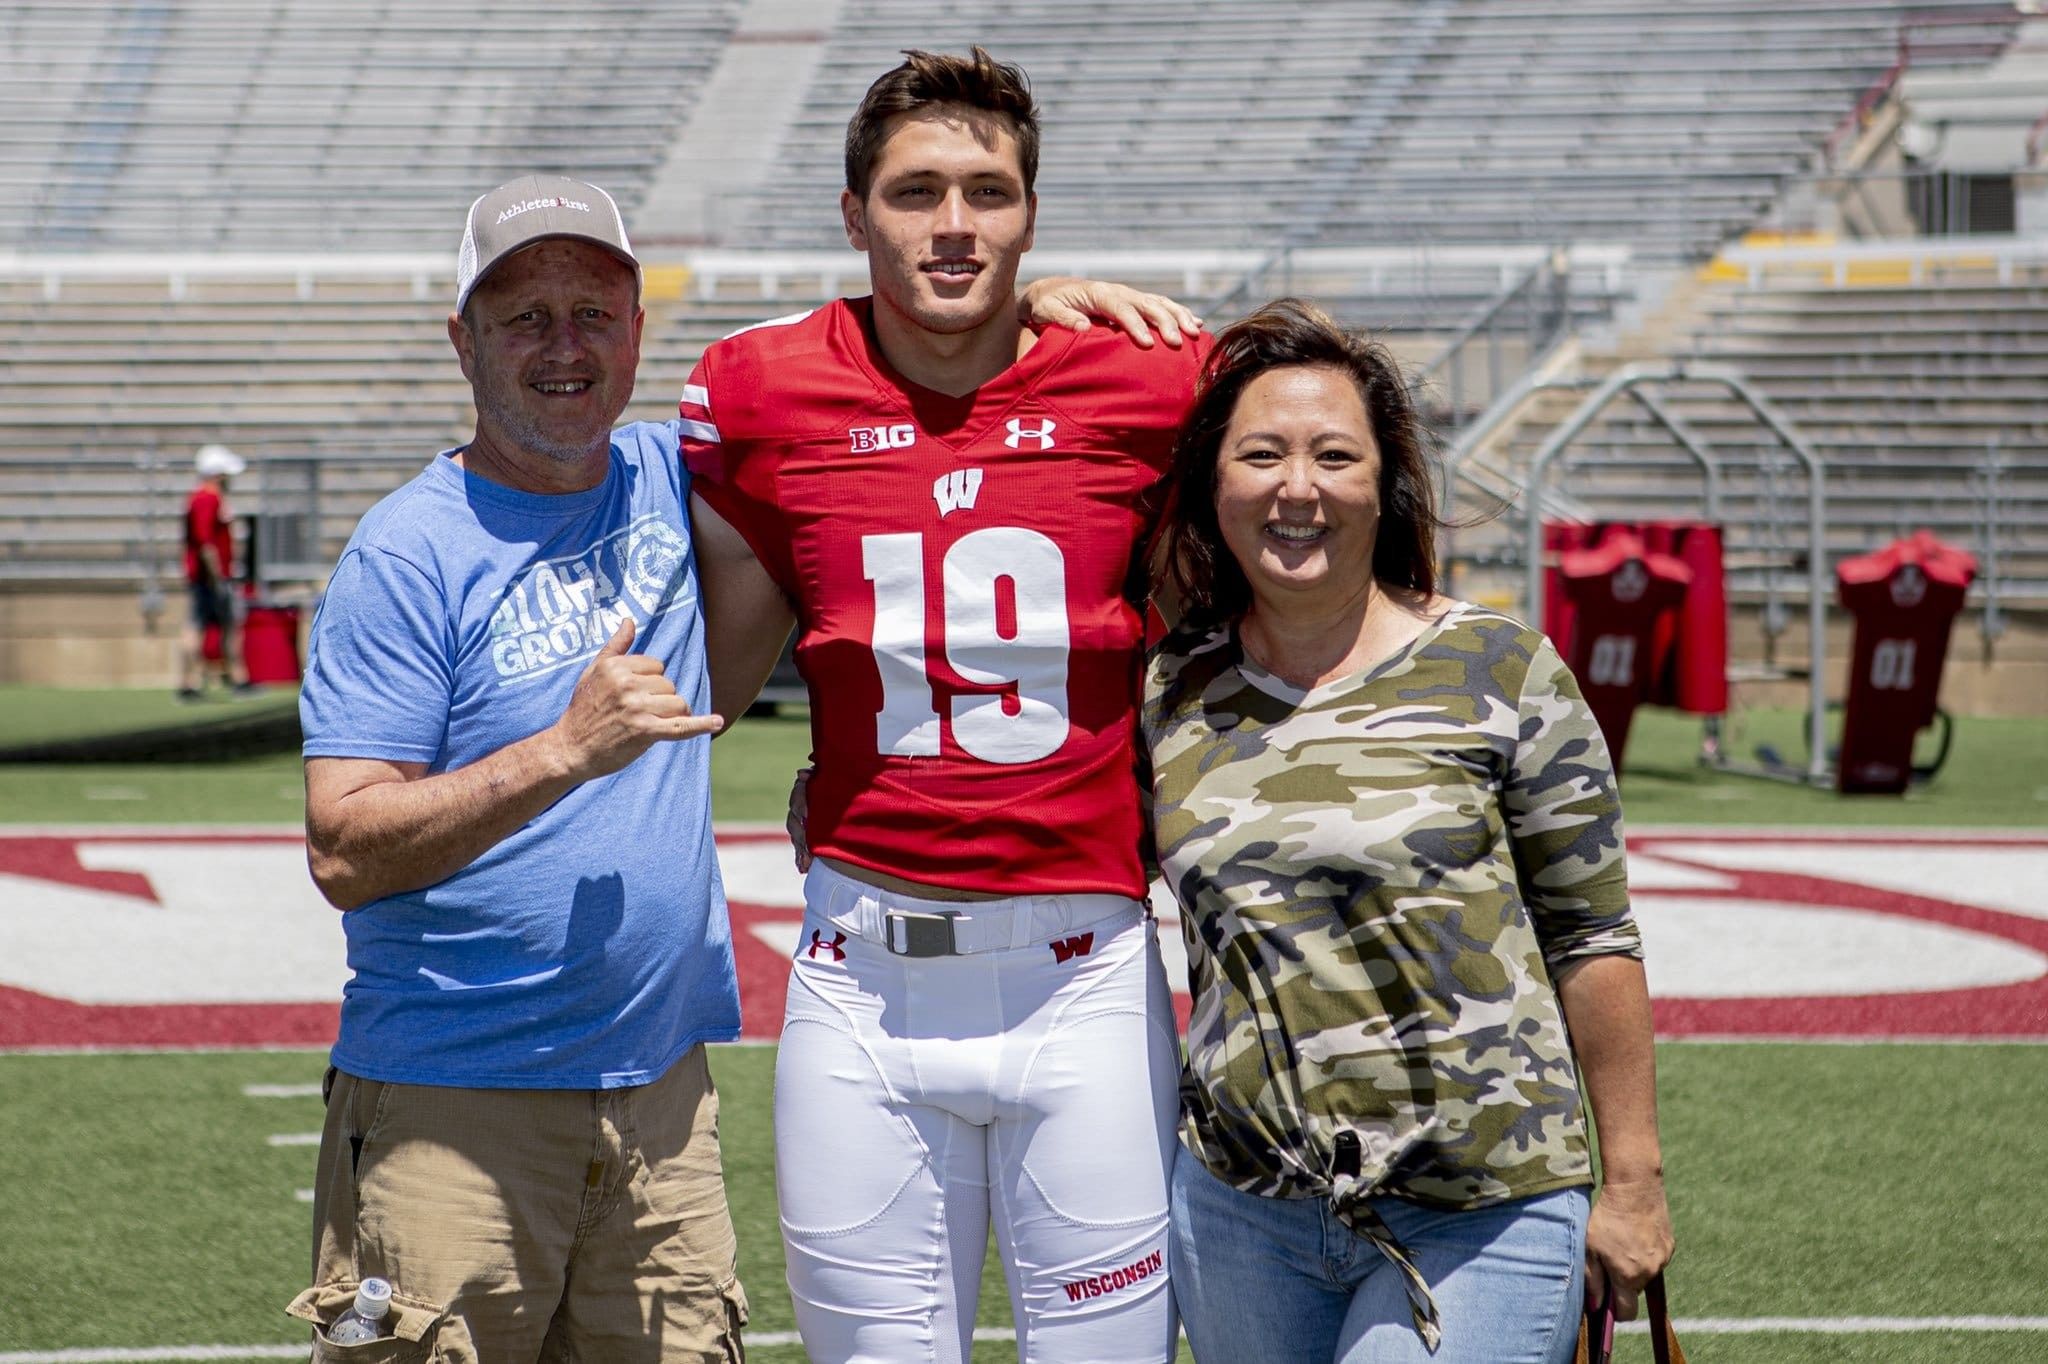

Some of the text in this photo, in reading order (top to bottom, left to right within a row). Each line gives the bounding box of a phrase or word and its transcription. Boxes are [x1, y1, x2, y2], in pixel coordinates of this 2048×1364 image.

[933, 468, 984, 519] W
[492, 596, 640, 677] GROWN
[861, 525, 1070, 764] 19
[1589, 634, 1637, 687] 01
[1870, 638, 1917, 691] 01
[1049, 931, 1095, 964] W
[1063, 1249, 1162, 1302] WISCONSIN
